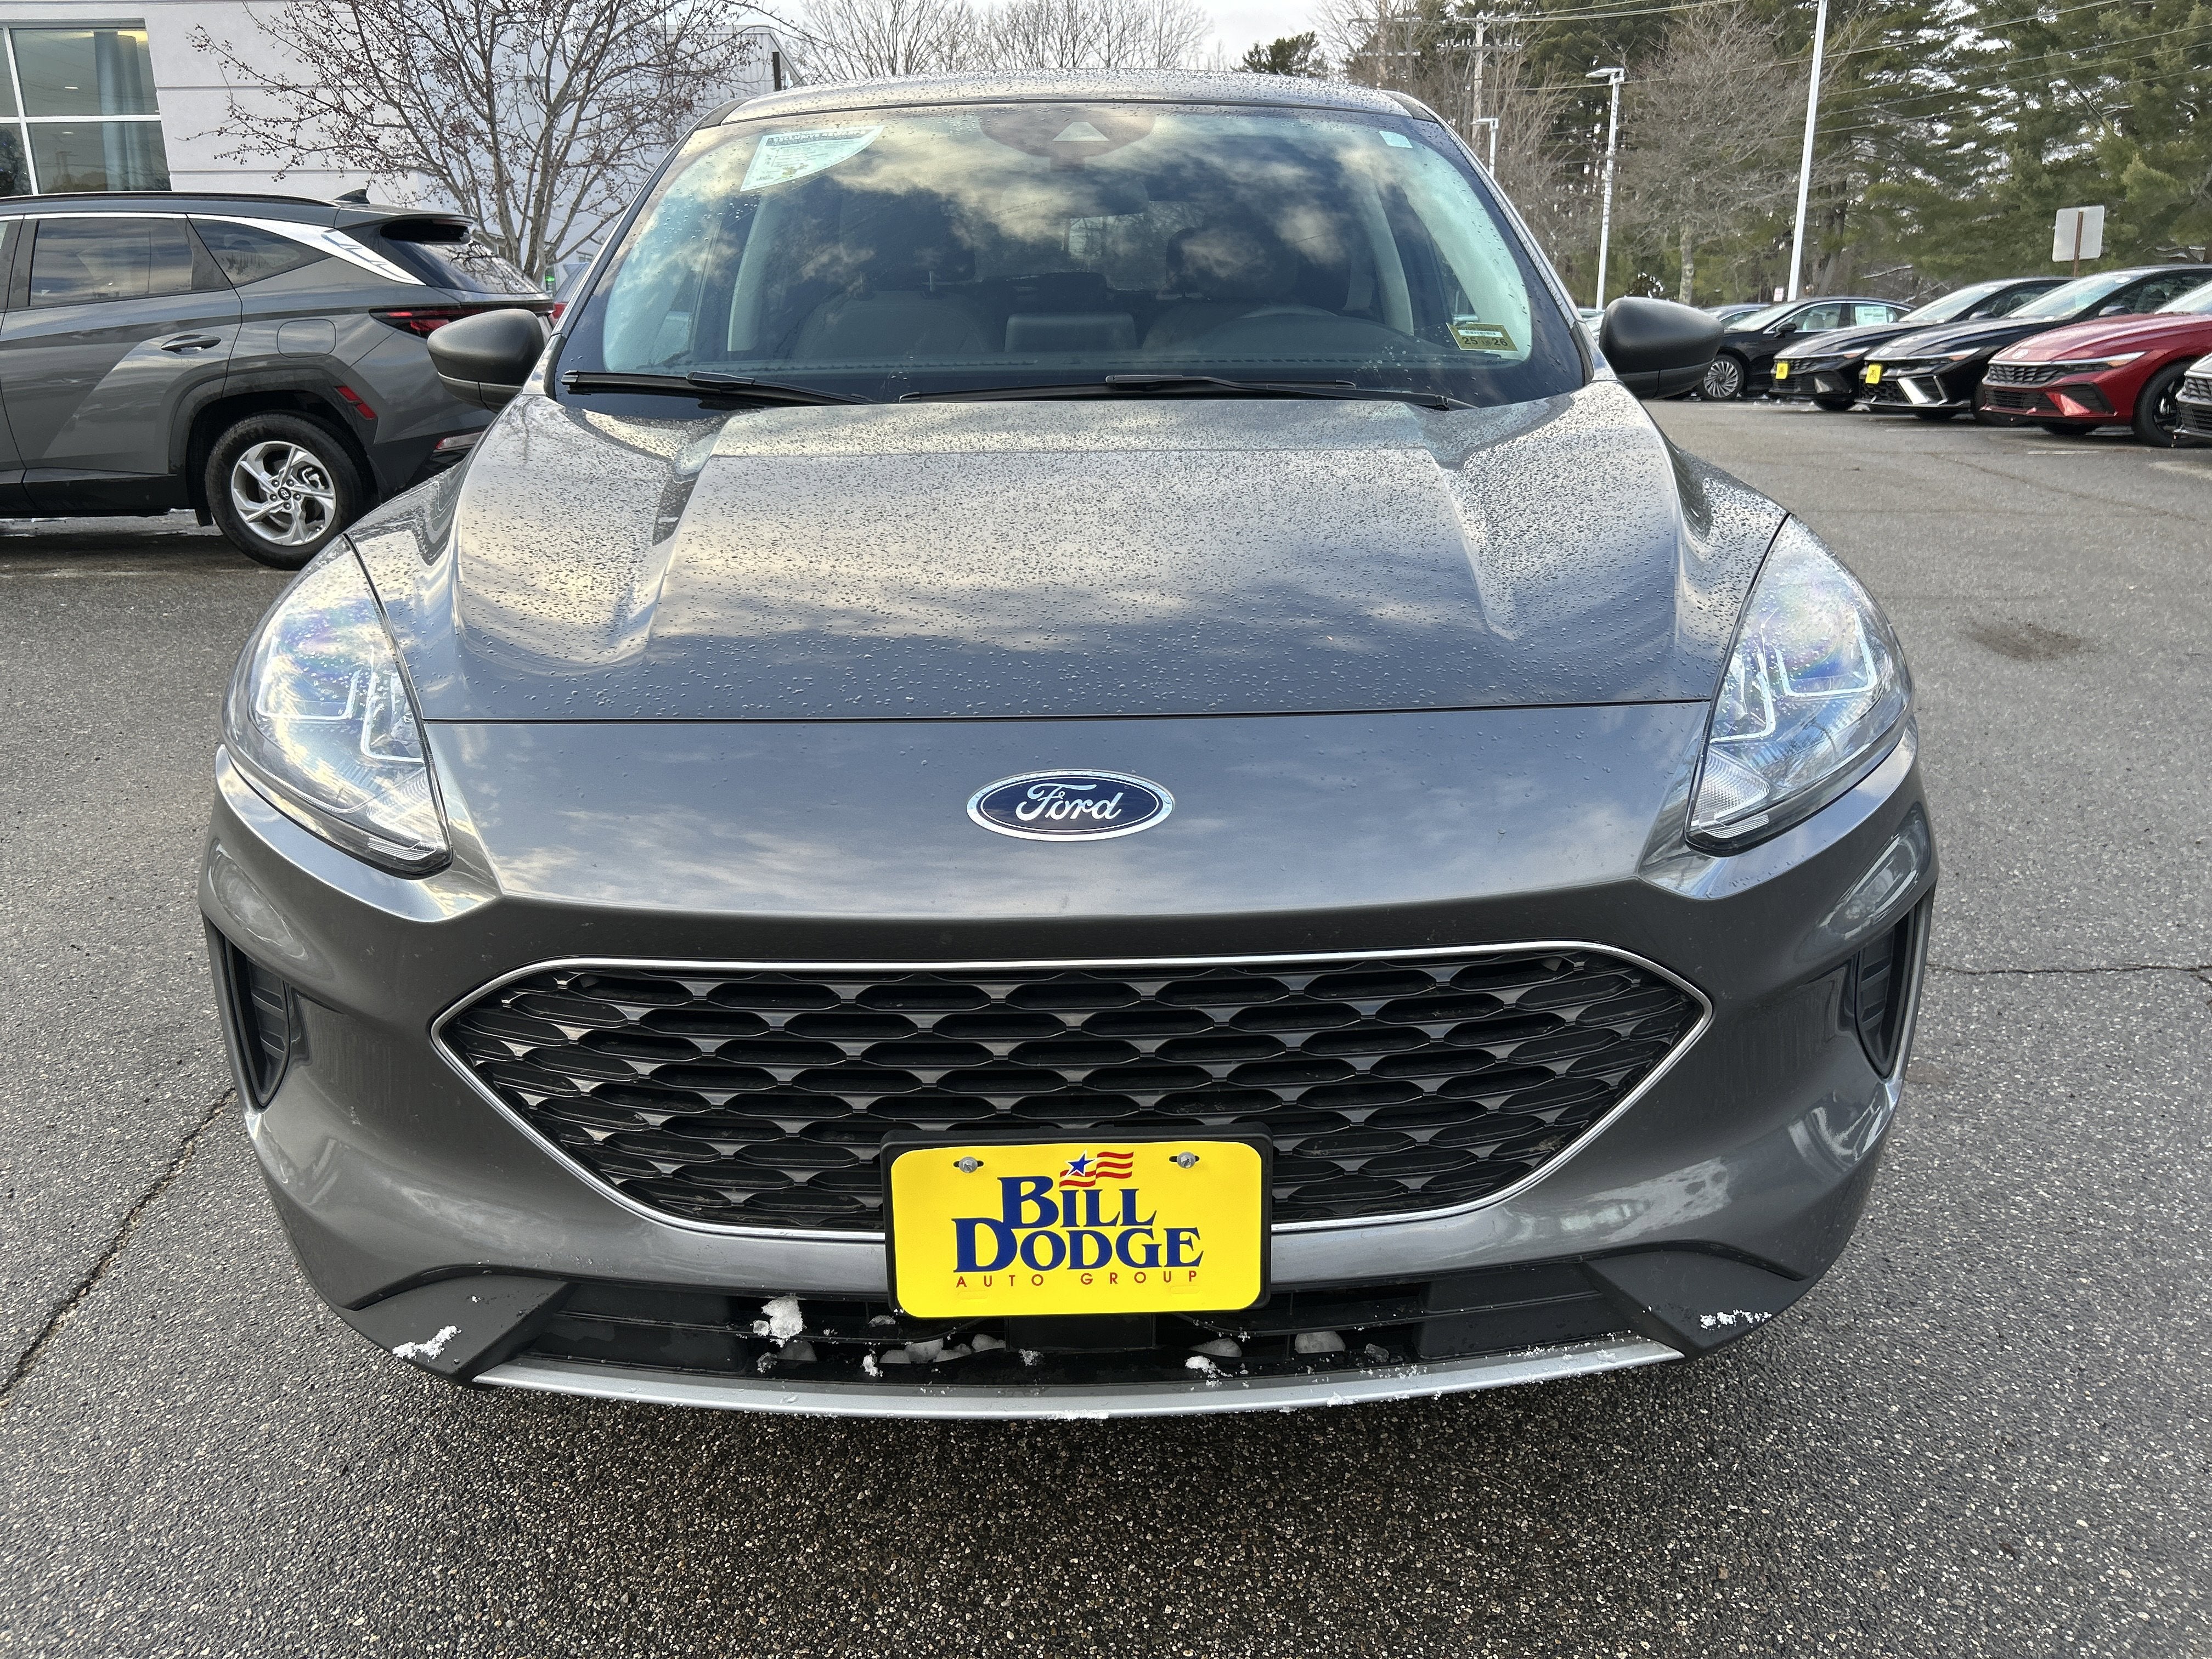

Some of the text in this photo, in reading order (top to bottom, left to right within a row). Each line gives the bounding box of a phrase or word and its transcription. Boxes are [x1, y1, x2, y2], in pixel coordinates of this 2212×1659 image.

[1462, 336, 1479, 345] 25
[1491, 337, 1508, 347] 26
[1015, 783, 1124, 821] Ford
[997, 1175, 1158, 1229] BILL
[951, 1217, 1204, 1273] DODGE
[956, 1271, 1198, 1288] AUTO GROUP
